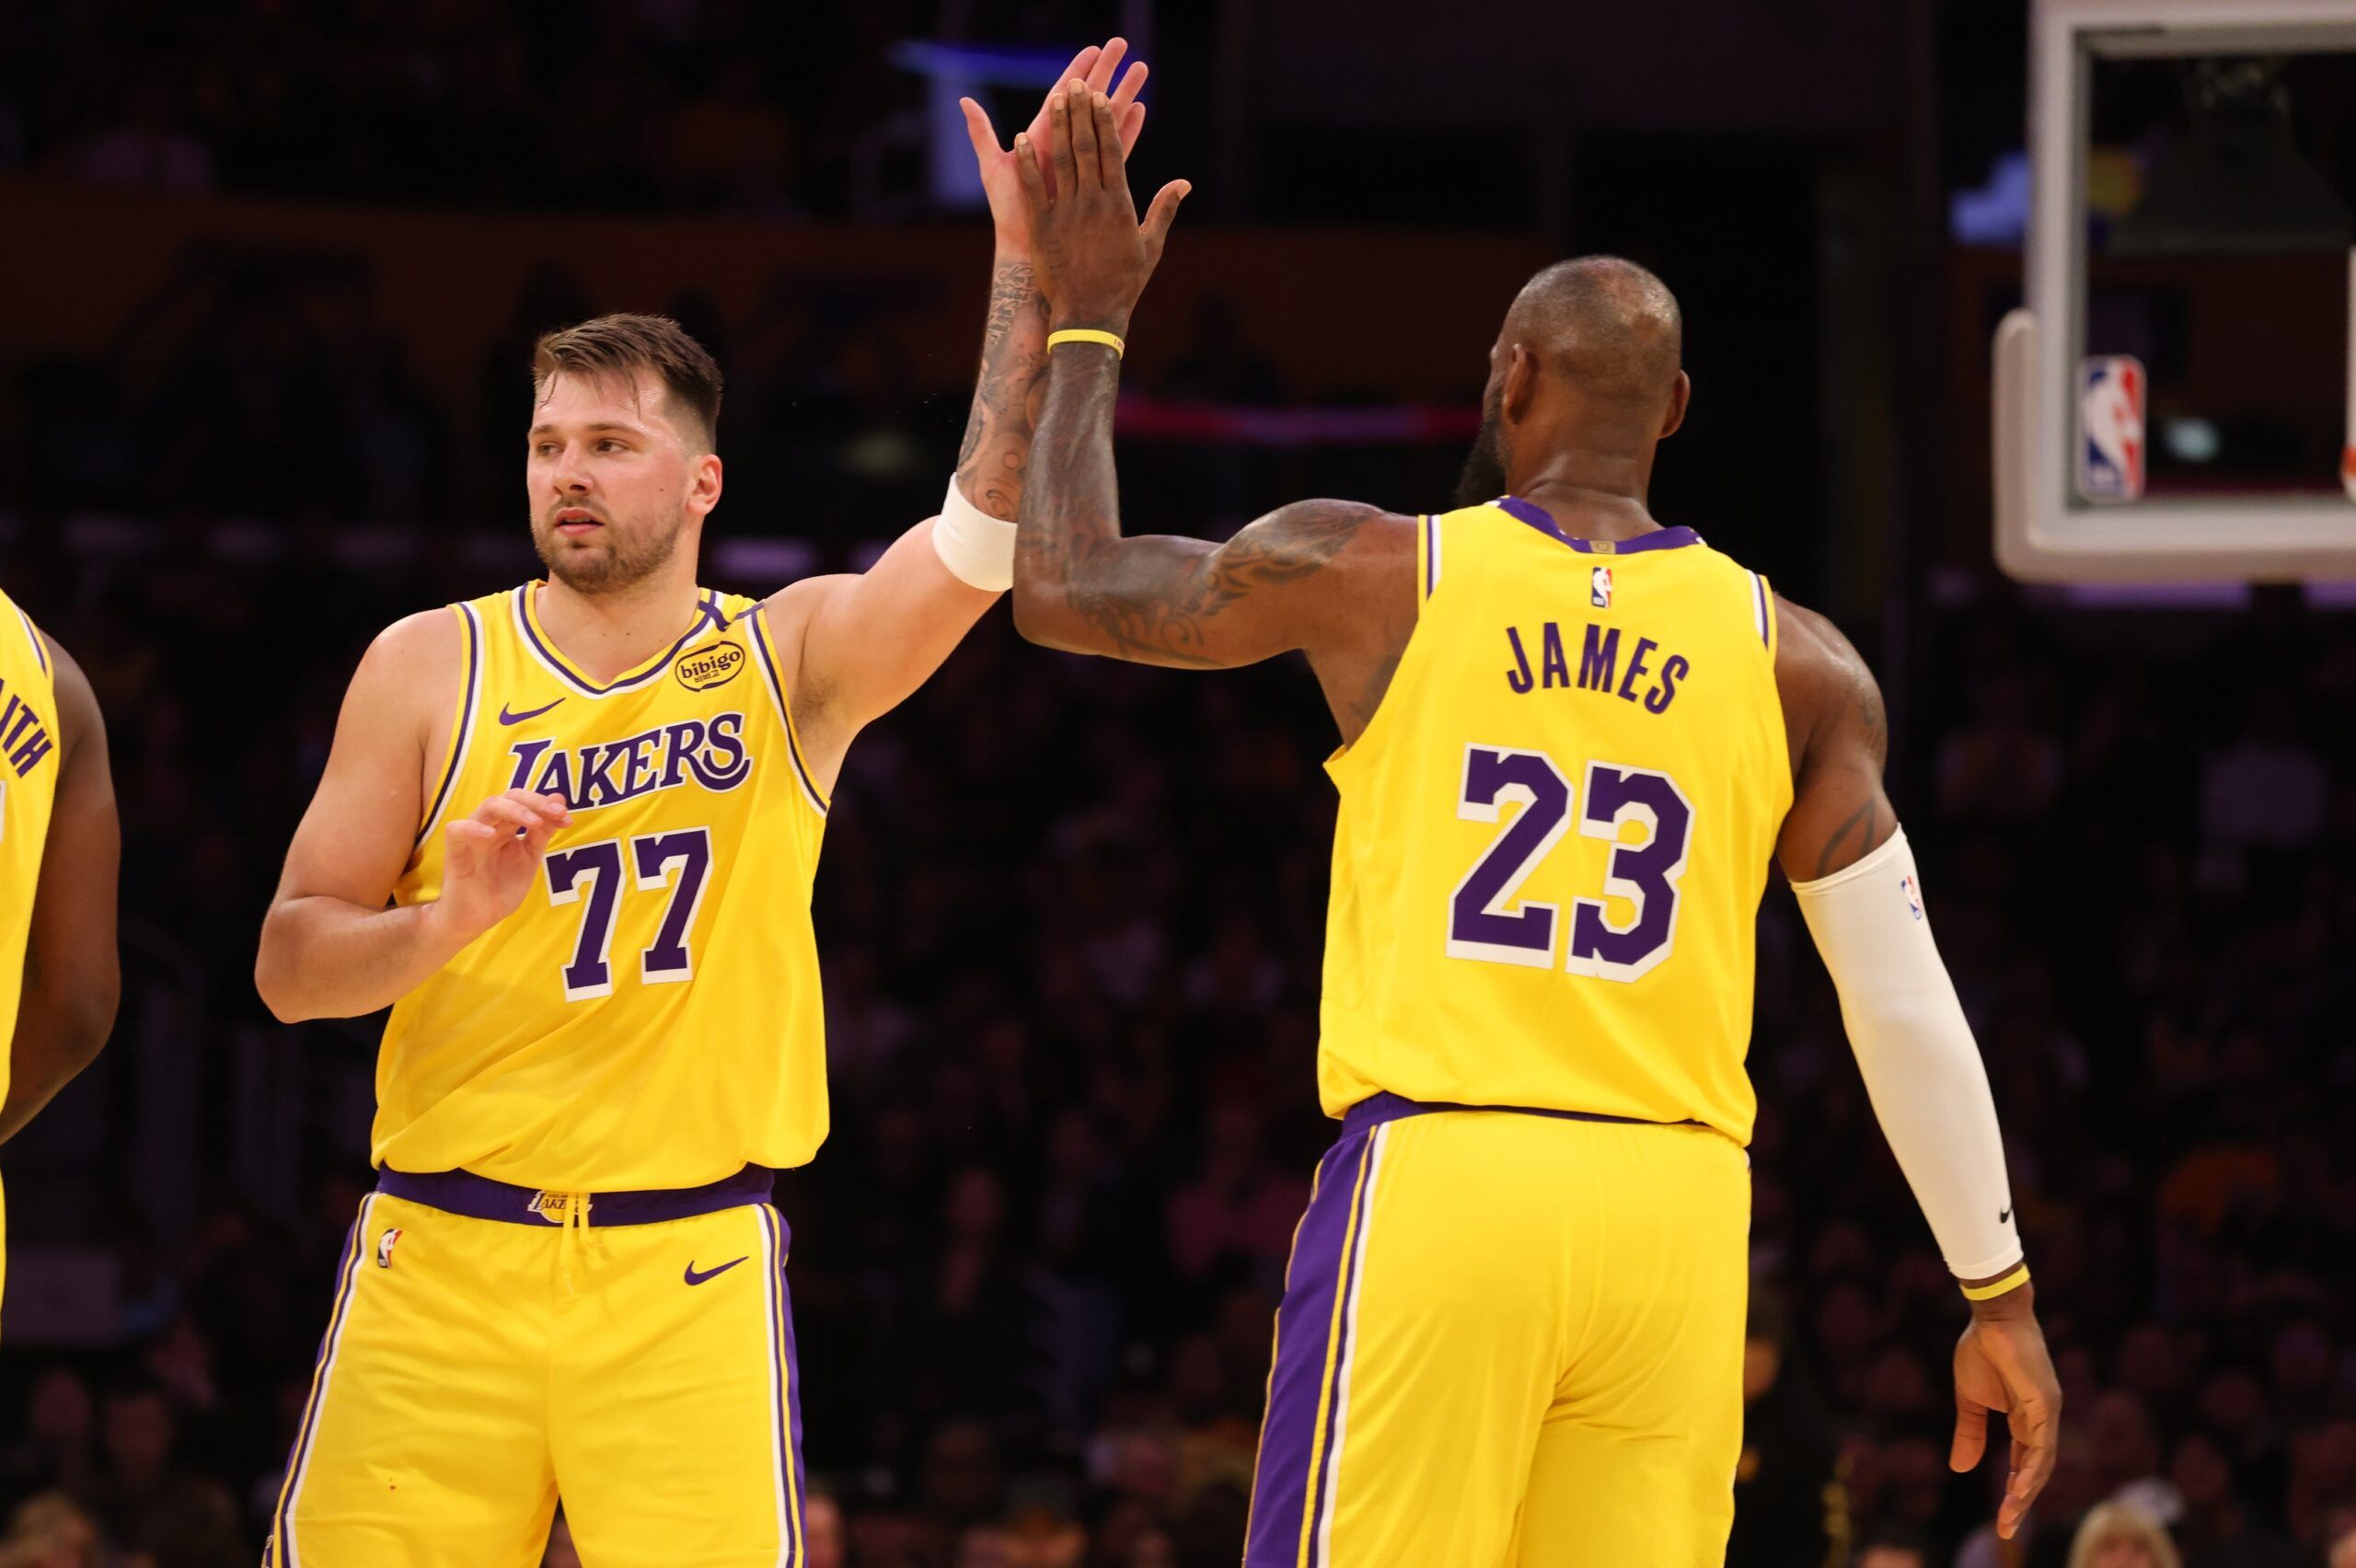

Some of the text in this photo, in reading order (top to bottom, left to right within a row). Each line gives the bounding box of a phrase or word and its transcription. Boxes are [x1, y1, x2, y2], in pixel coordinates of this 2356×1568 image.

[680, 651, 741, 678] bibigo
[1506, 622, 1690, 715] JAMES
[0, 679, 53, 778] ITH
[1445, 742, 1696, 984] 23
[544, 825, 714, 1002] 77
